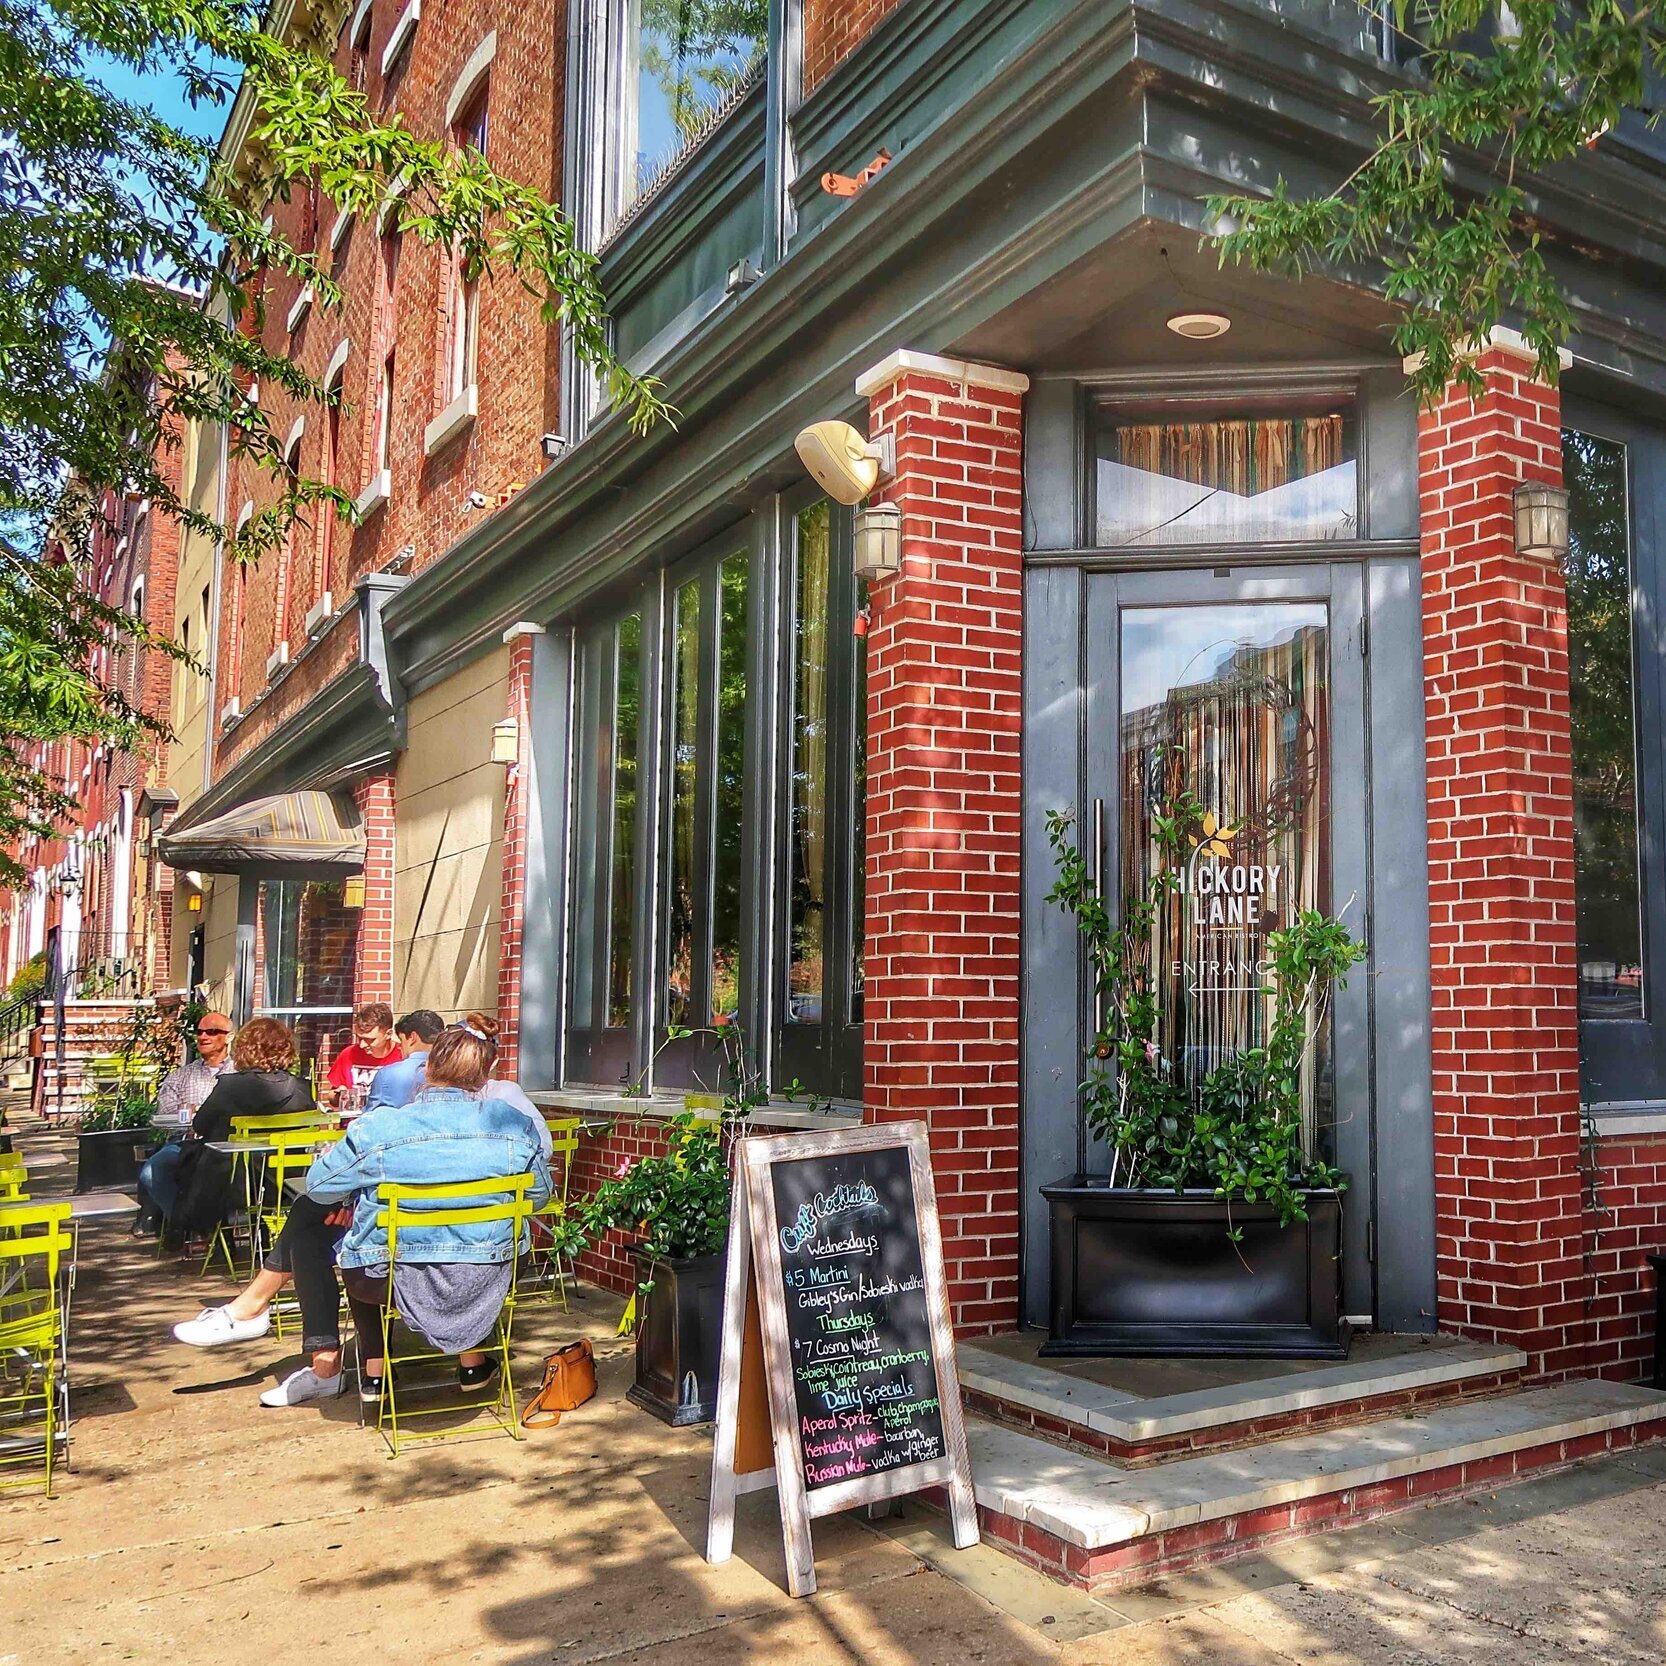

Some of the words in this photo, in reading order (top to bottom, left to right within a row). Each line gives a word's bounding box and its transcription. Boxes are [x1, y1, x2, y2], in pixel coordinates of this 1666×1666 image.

[1171, 865, 1281, 894] HICKORY
[1194, 896, 1260, 924] LANE
[1171, 960, 1277, 976] ENTRANC
[807, 1230, 879, 1257] Wednesdays
[809, 1265, 849, 1285] Martini
[816, 1309, 876, 1333] Thursdays
[816, 1339, 849, 1355] Cosmo
[851, 1330, 881, 1356] Night
[807, 1380, 830, 1394] lime
[834, 1375, 858, 1392] juice
[821, 1389, 863, 1412] Daily
[862, 1375, 915, 1404] Specials
[804, 1435, 855, 1459] Kentucky
[918, 1448, 940, 1462] beer
[805, 1463, 846, 1485] Russian
